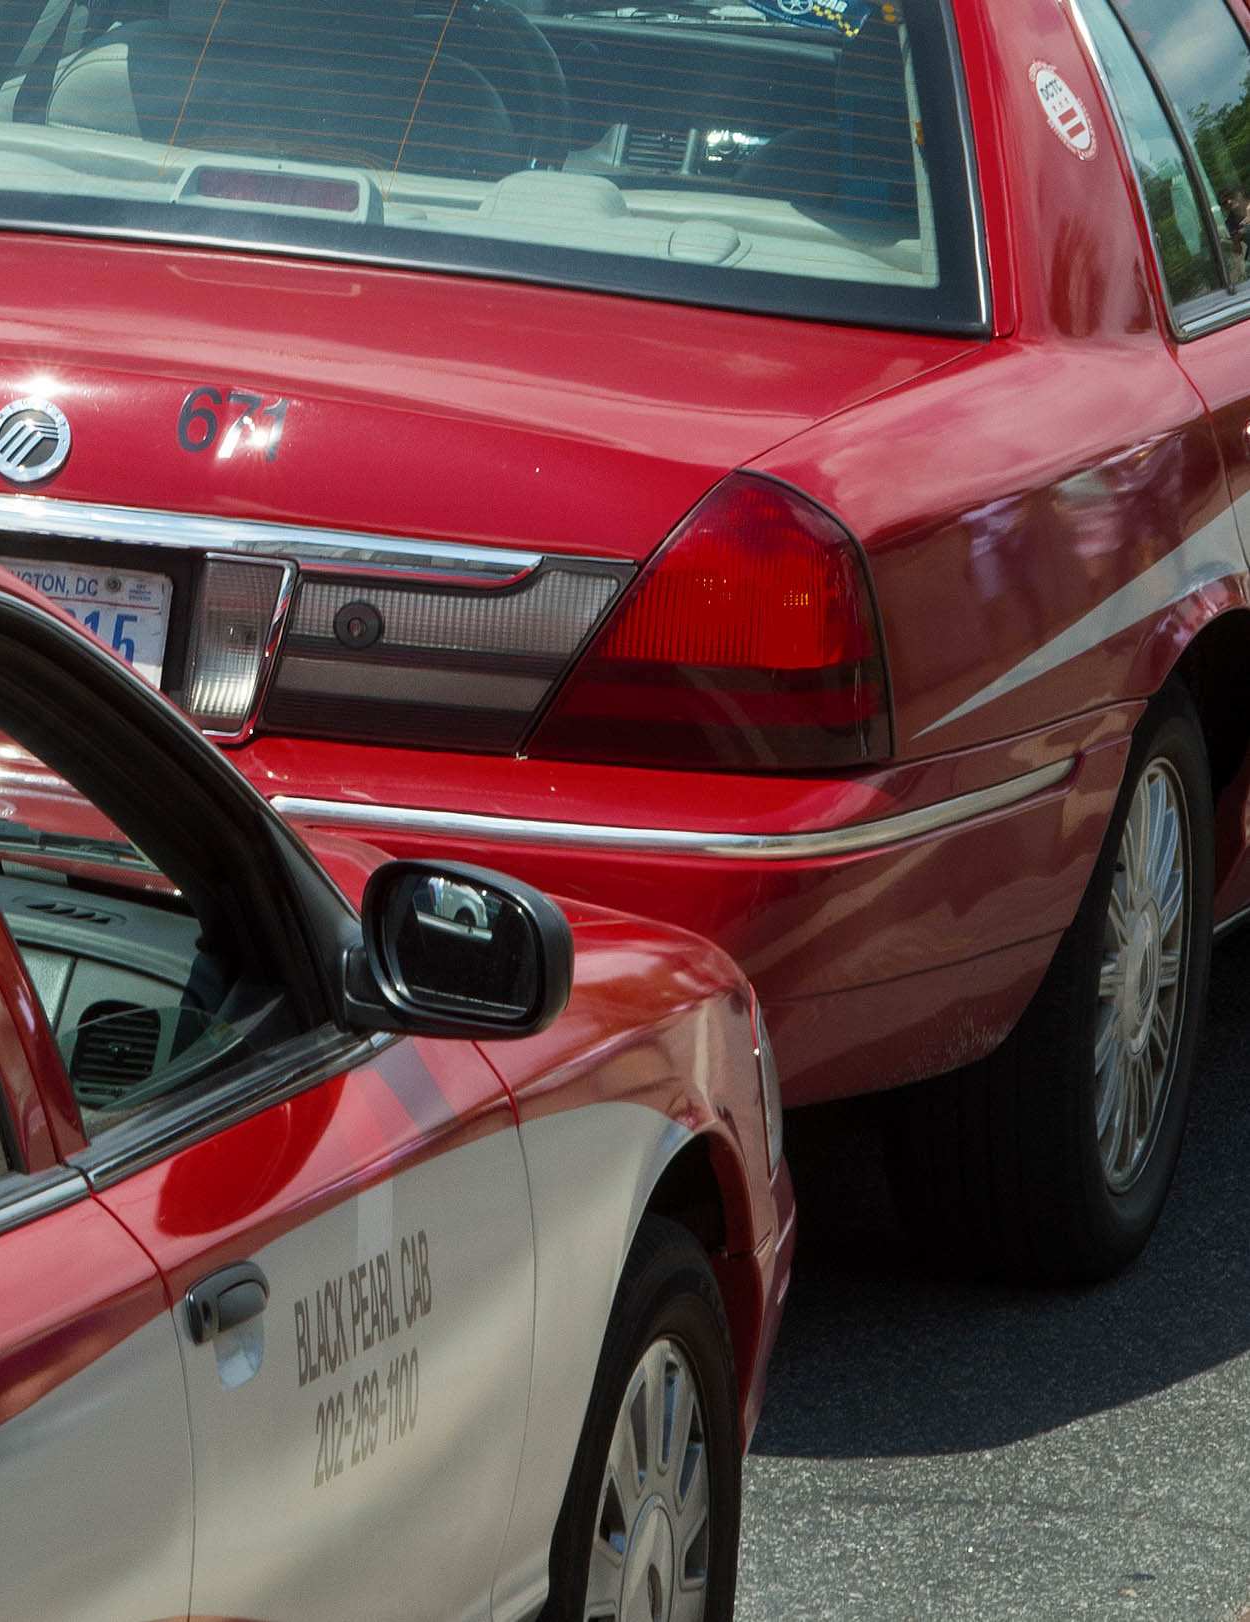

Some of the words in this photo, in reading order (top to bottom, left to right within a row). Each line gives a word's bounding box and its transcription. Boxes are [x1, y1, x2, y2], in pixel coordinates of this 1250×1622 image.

[176, 386, 288, 462] 671
[75, 577, 98, 596] DC
[294, 1276, 349, 1388] BLACK
[349, 1250, 400, 1357] PEARL
[401, 1229, 432, 1328] CAB
[314, 1346, 419, 1488] 202-269-1100
